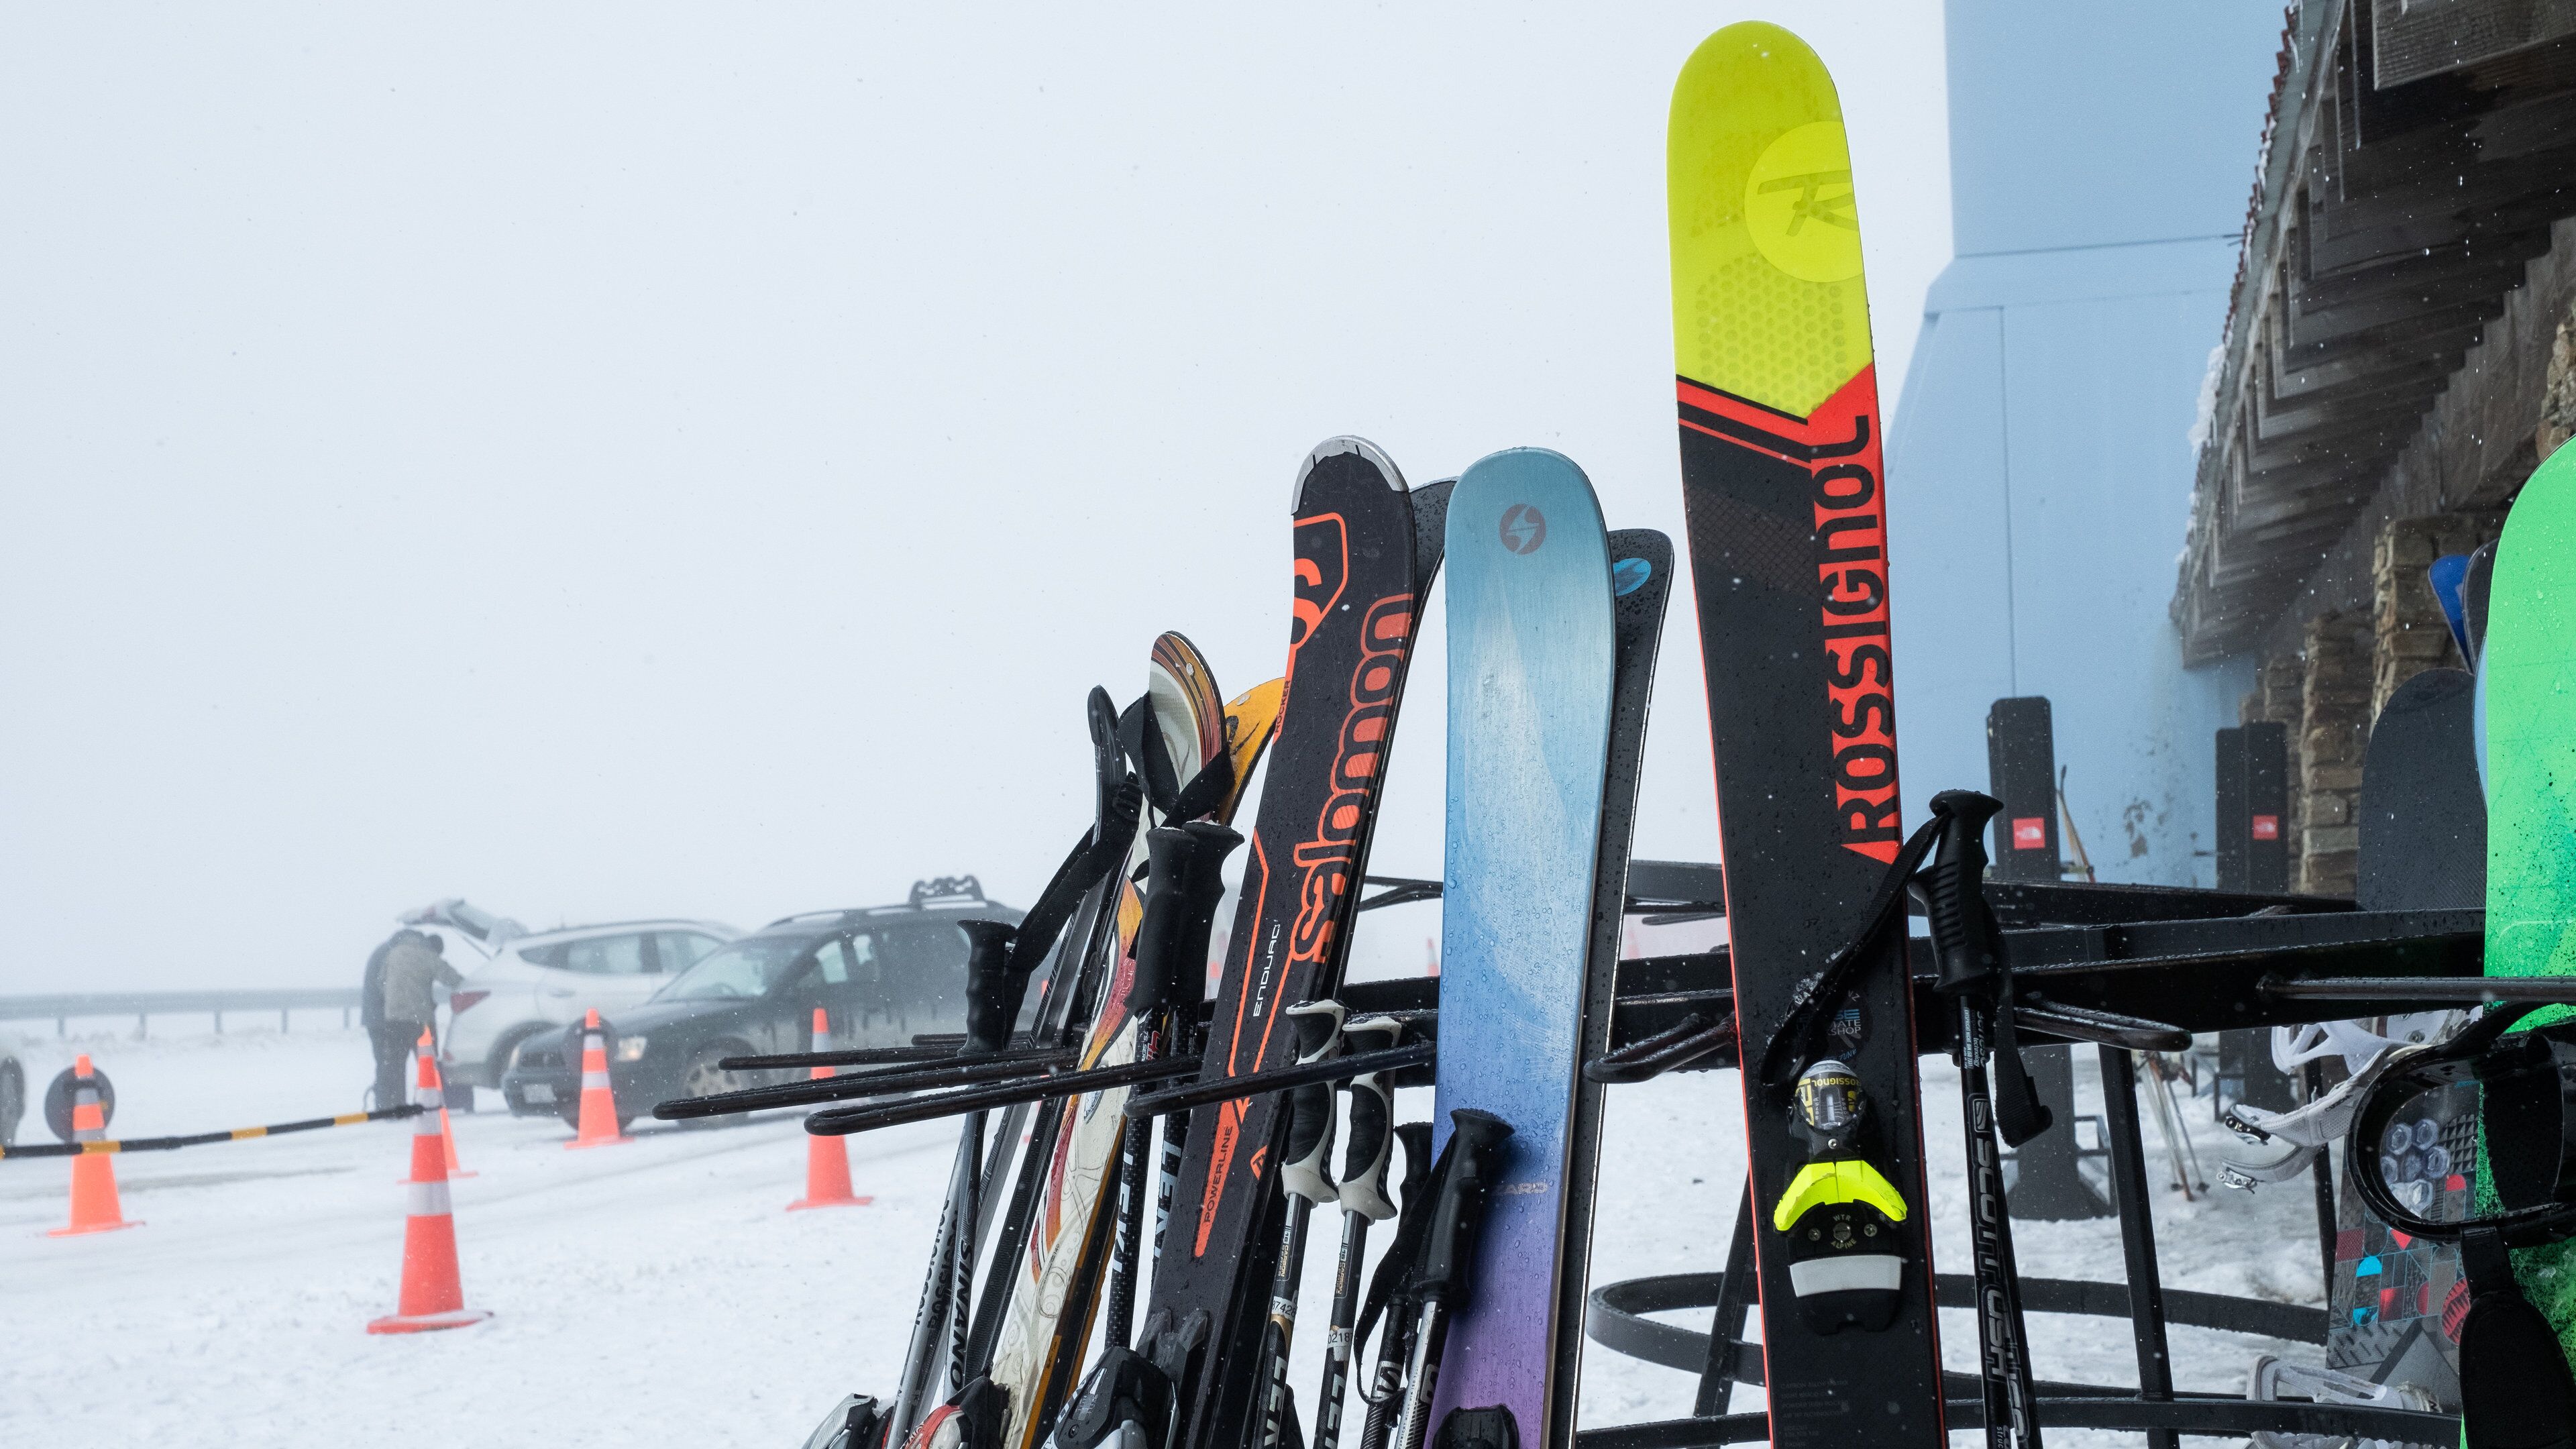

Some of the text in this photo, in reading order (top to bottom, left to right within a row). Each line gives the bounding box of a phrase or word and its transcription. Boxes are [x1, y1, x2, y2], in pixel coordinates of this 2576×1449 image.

[1811, 414, 1899, 845] ROSSIGNOL
[1203, 1126, 1233, 1223] POWERLINE
[1833, 1214, 1851, 1222] WTR
[1830, 1237, 1857, 1249] ALPINE
[1281, 1244, 1289, 1277] CARBON
[1338, 1262, 1346, 1295] CARBON
[950, 1238, 973, 1393] SINANO
